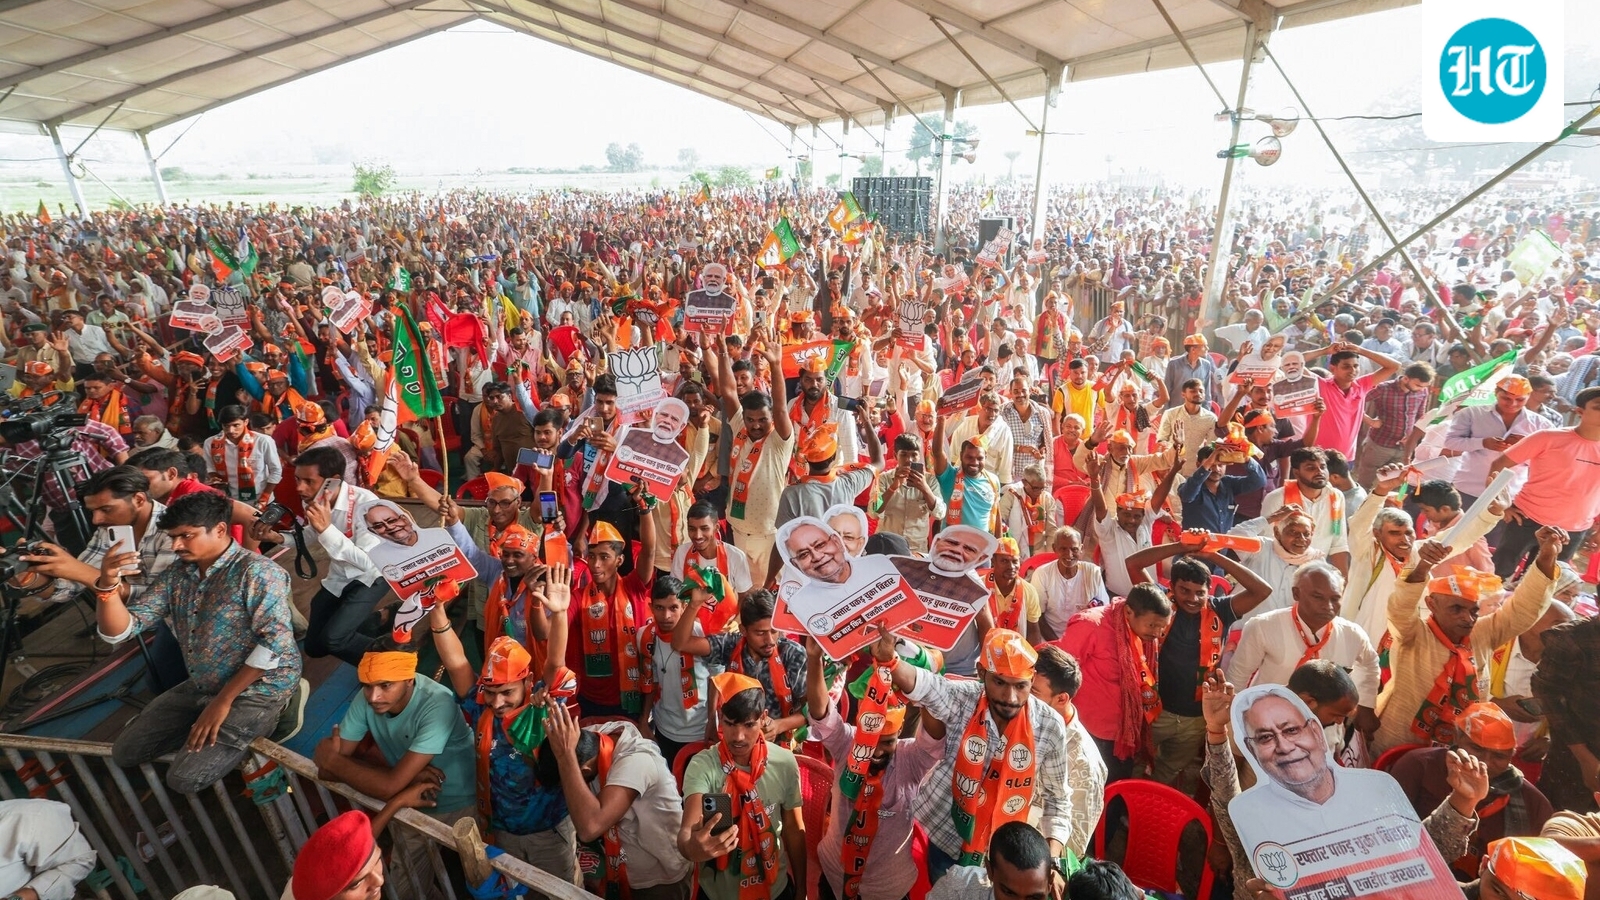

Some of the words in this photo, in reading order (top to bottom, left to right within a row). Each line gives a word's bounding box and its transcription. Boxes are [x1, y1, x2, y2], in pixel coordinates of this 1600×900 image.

[864, 588, 878, 601] चुका
[876, 577, 896, 591] बिहार
[841, 626, 852, 635] बार
[852, 618, 864, 630] फिर
[883, 593, 904, 609] सरकार
[949, 600, 969, 614] बिहार
[932, 615, 956, 627] सरकार
[868, 686, 888, 705] BJ
[1293, 847, 1329, 867] रफ्तार
[1327, 841, 1357, 857] पकड़
[1355, 832, 1378, 855] चुका
[1376, 823, 1413, 845] बिहार
[1325, 881, 1349, 899] फिर
[1352, 872, 1389, 893] एनडीए
[1388, 863, 1430, 883] सरकार
